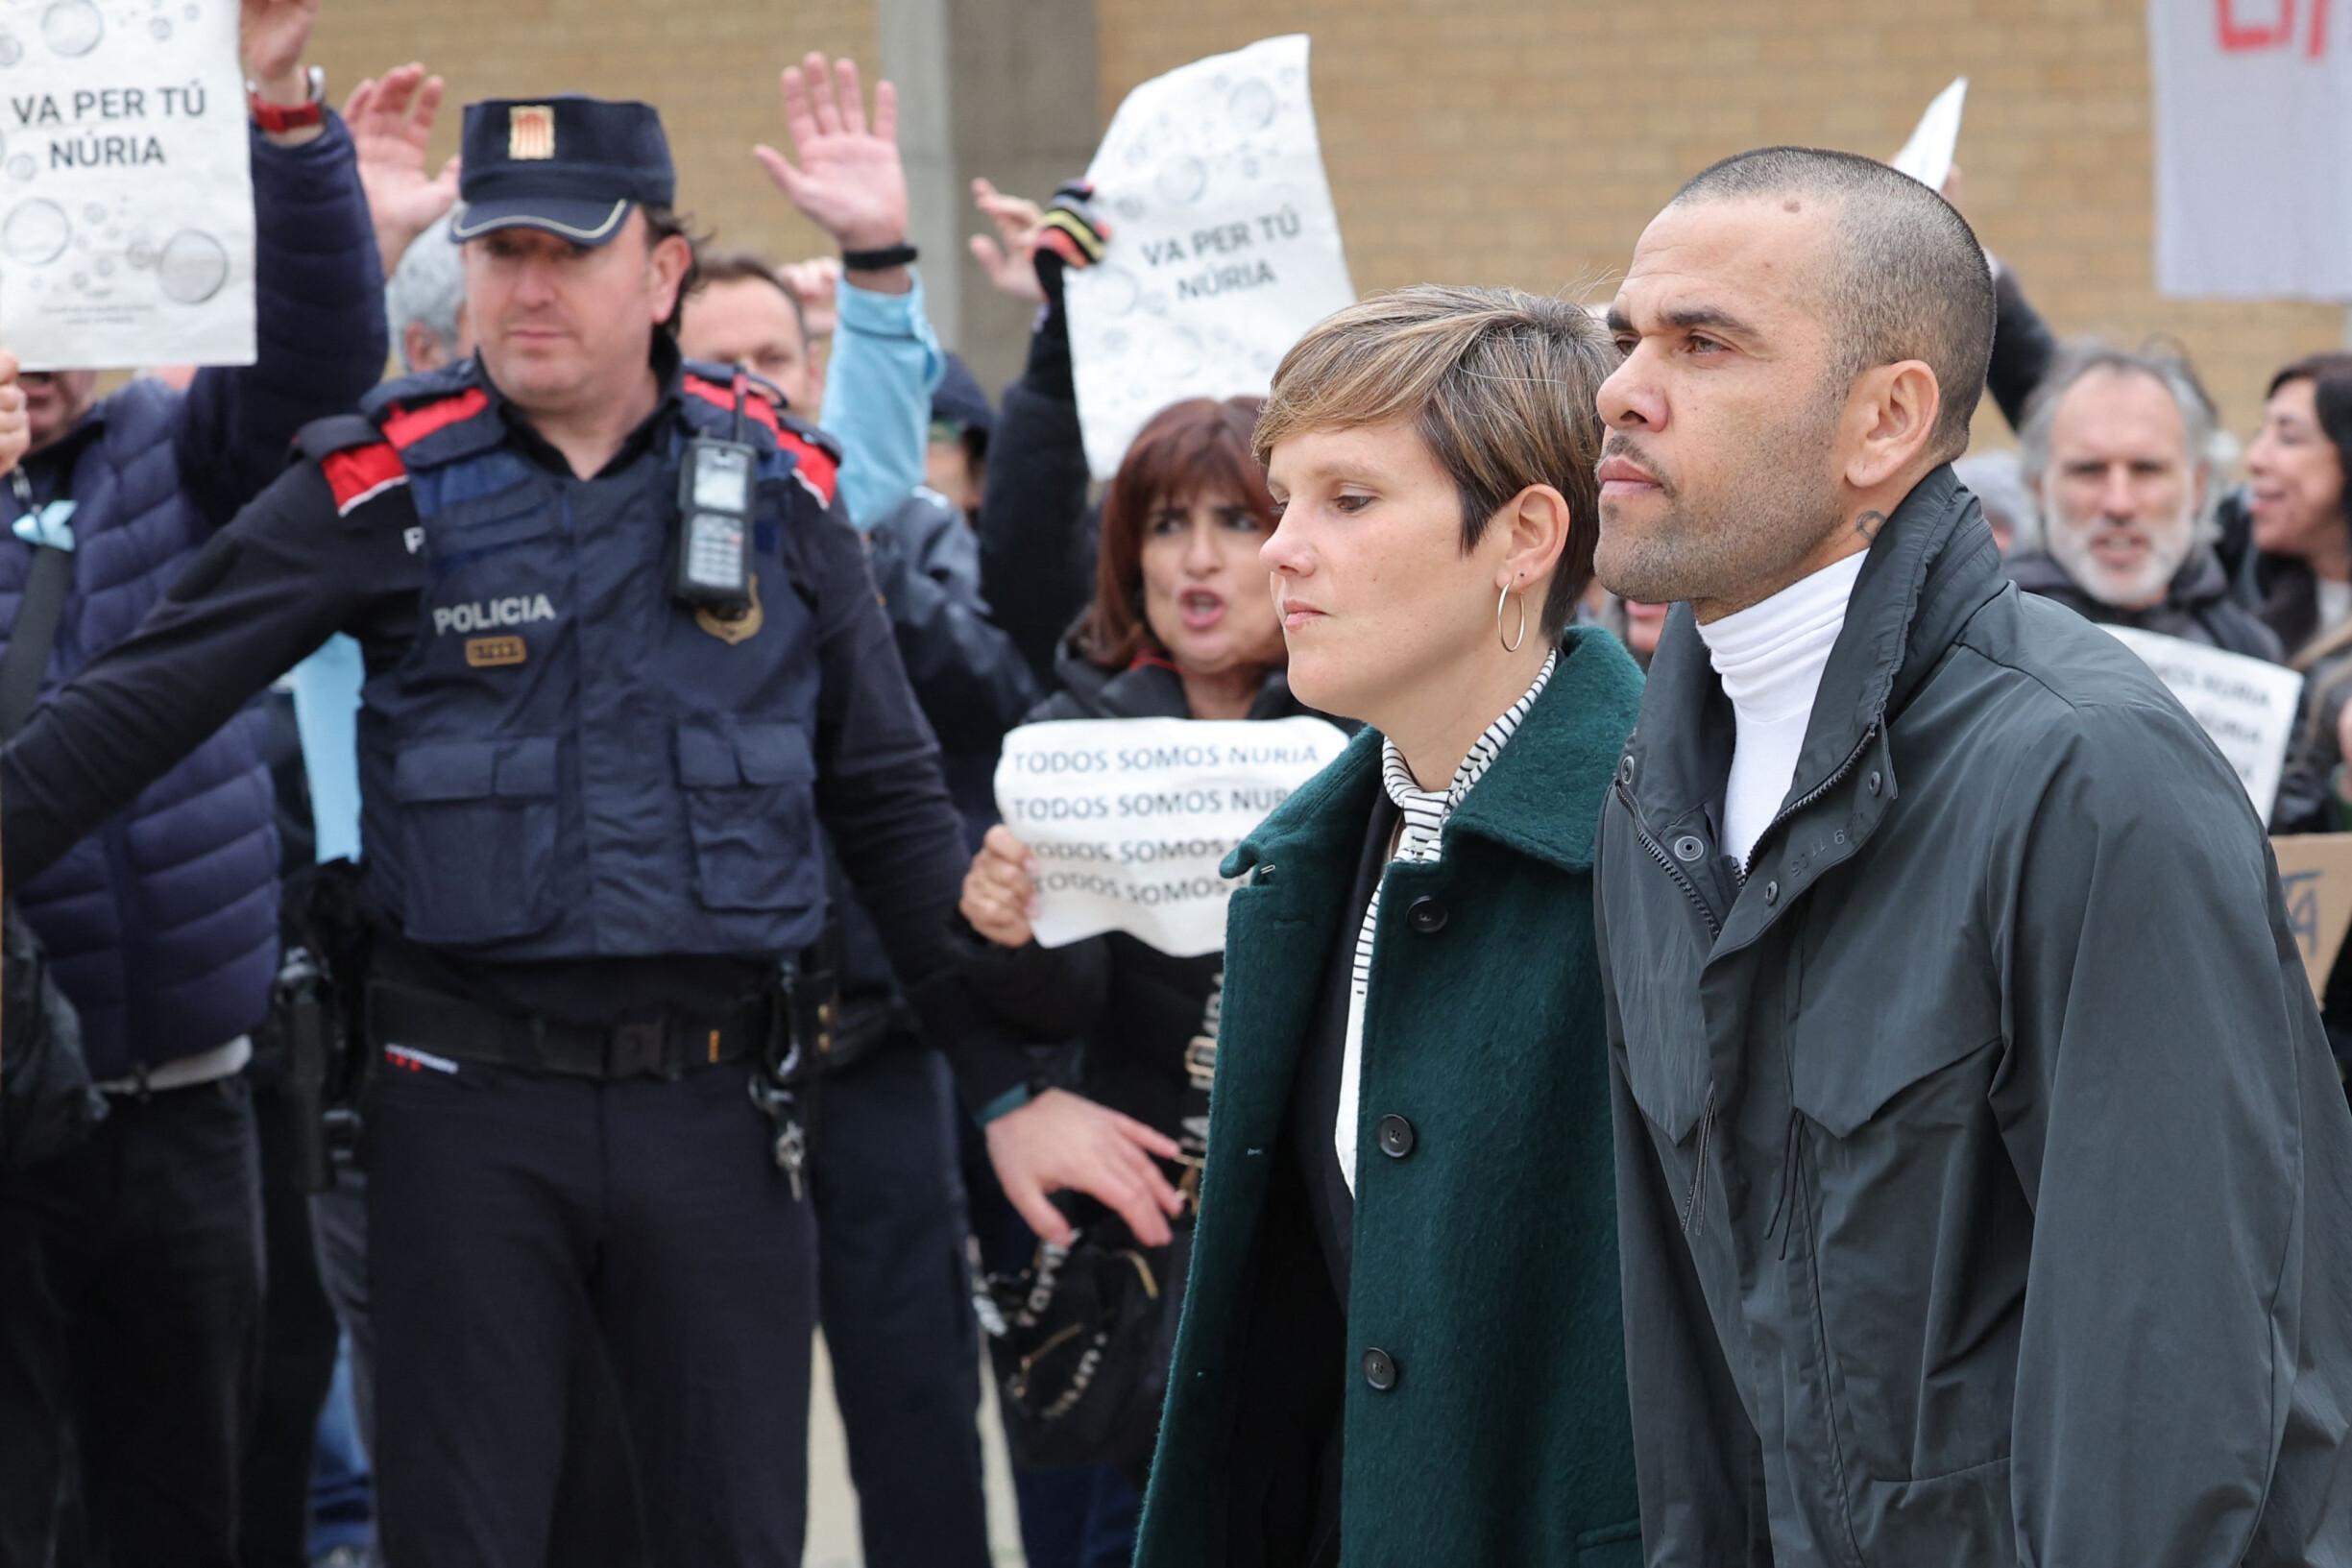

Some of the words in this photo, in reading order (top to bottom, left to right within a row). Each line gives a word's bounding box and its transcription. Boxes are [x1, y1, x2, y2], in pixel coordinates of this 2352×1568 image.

[12, 93, 61, 126] VA
[74, 87, 145, 119] PER
[157, 79, 206, 117] TÚ
[50, 130, 165, 169] NÚRIA
[1140, 238, 1186, 266] VA
[1191, 221, 1252, 256] PER
[433, 592, 557, 637] POLICIA
[1014, 749, 1107, 774] TODOS
[1118, 745, 1220, 771] SOMOS
[1014, 795, 1108, 820] TODOS
[1118, 790, 1222, 817] SOMOS
[1230, 786, 1290, 812] NUR
[1026, 841, 1111, 862] ODOS
[1120, 840, 1224, 863] SOMOS
[1128, 878, 1227, 906] SOMOS
